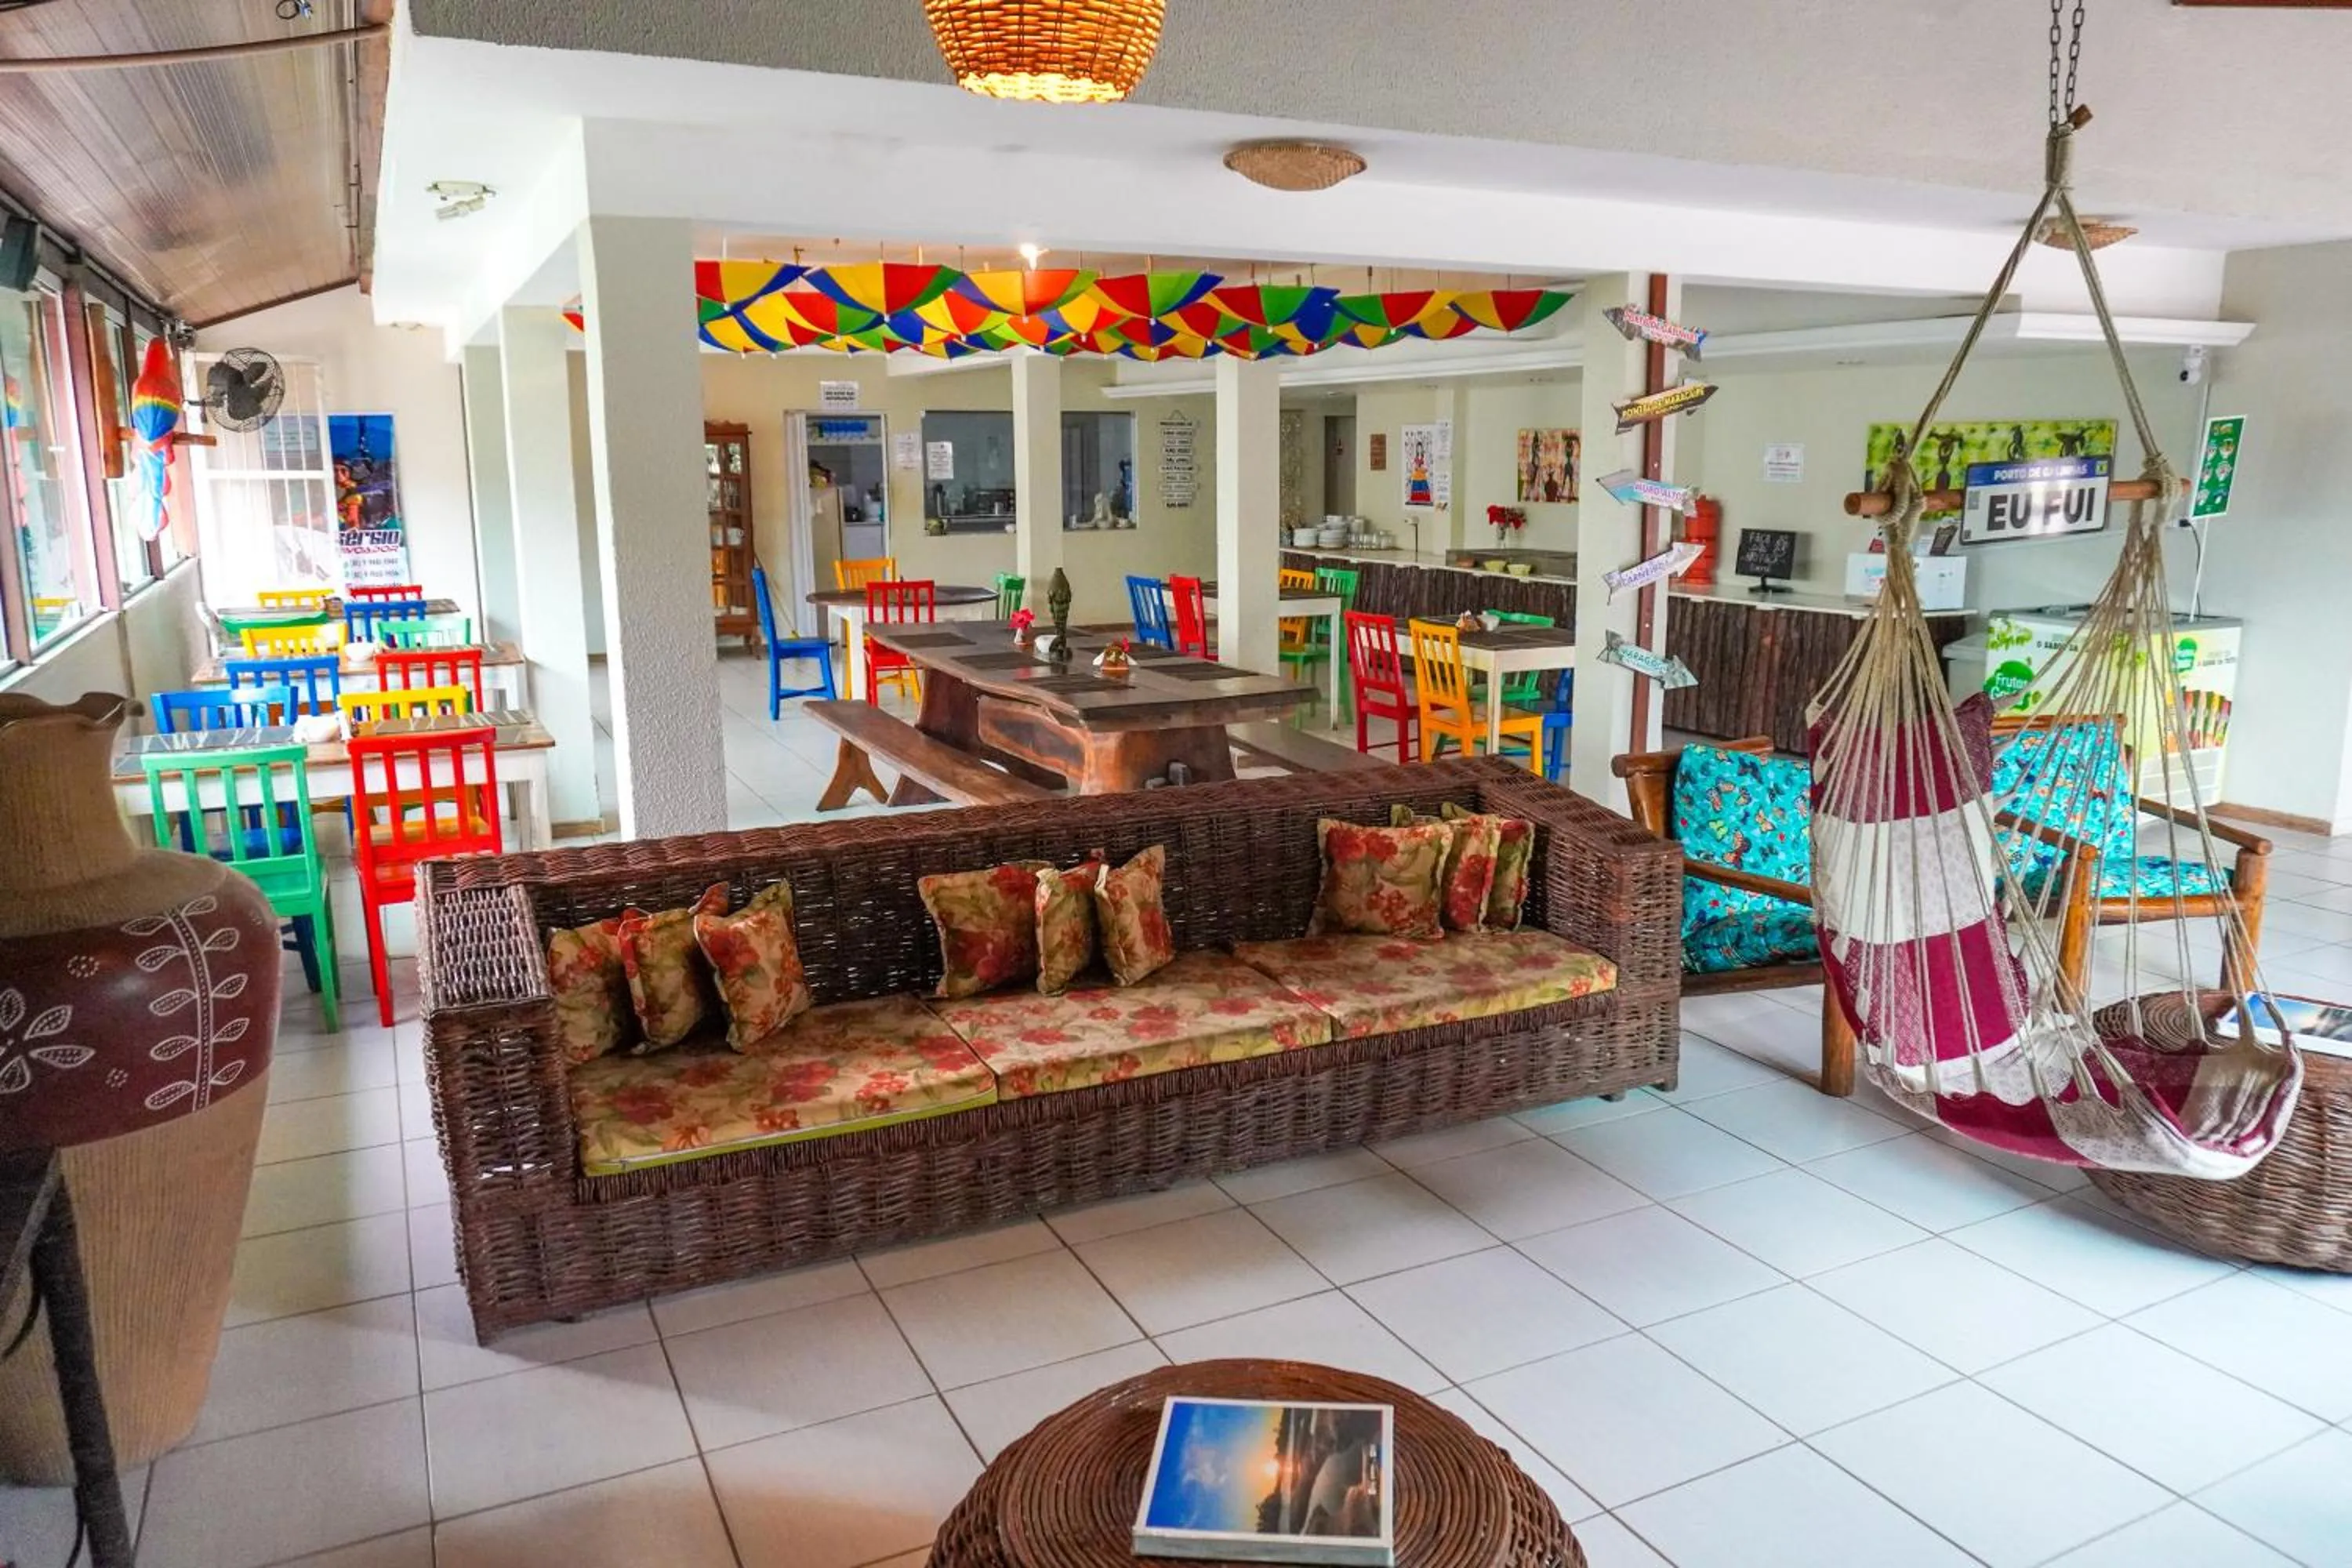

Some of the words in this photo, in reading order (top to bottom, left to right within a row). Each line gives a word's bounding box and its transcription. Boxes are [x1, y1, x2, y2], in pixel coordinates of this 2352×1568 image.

[1994, 468, 2027, 481] PORTO
[2028, 466, 2042, 478] DE
[1987, 492, 2033, 531] EU
[2043, 487, 2096, 525] FUI
